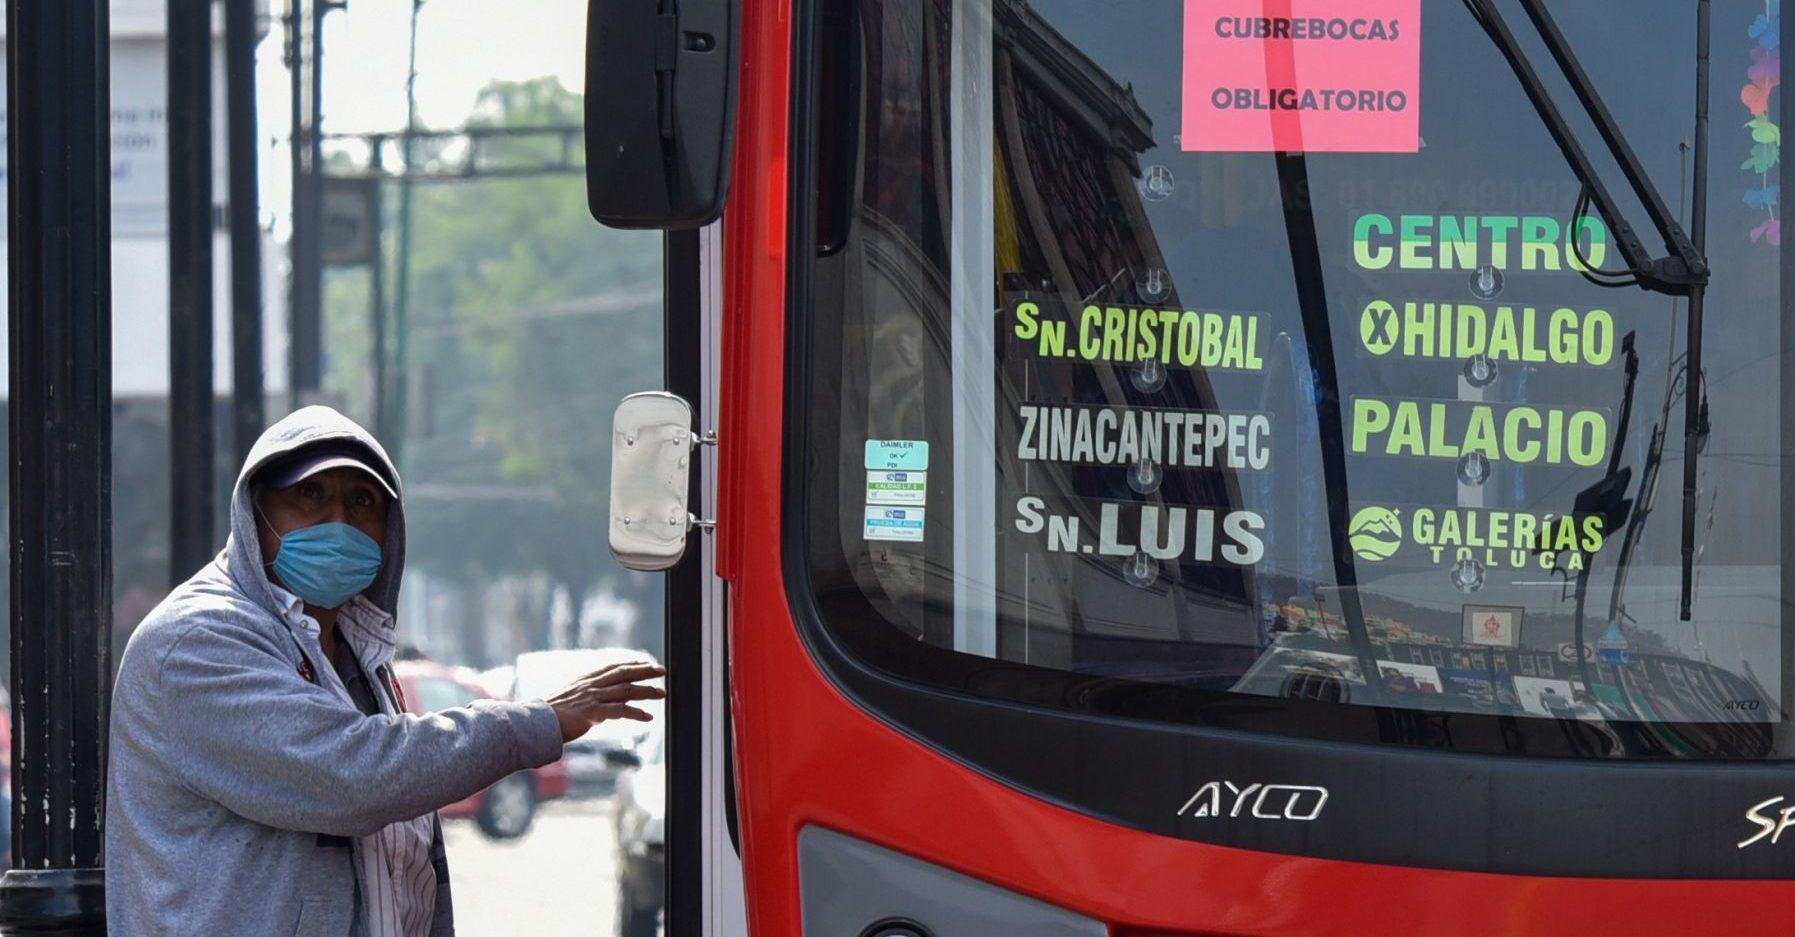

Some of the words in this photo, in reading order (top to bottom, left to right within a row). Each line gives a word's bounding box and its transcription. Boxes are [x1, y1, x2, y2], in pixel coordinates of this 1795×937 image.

[1215, 17, 1400, 41] CUBREBOCAS
[1211, 87, 1407, 112] OBLIGATORIO
[1353, 213, 1606, 271] CENTRO
[1079, 305, 1263, 370] CRISTOBAL
[1403, 302, 1614, 365] HIDALGO
[880, 441, 914, 449] DAIMLER
[1017, 405, 1270, 470] ZINACANTEPEC
[1352, 399, 1607, 467] PALACIO
[1099, 502, 1265, 565] LUIS
[1429, 546, 1584, 571] TOLUCA
[1723, 700, 1760, 711] AYCO
[1177, 781, 1329, 822] AYCO
